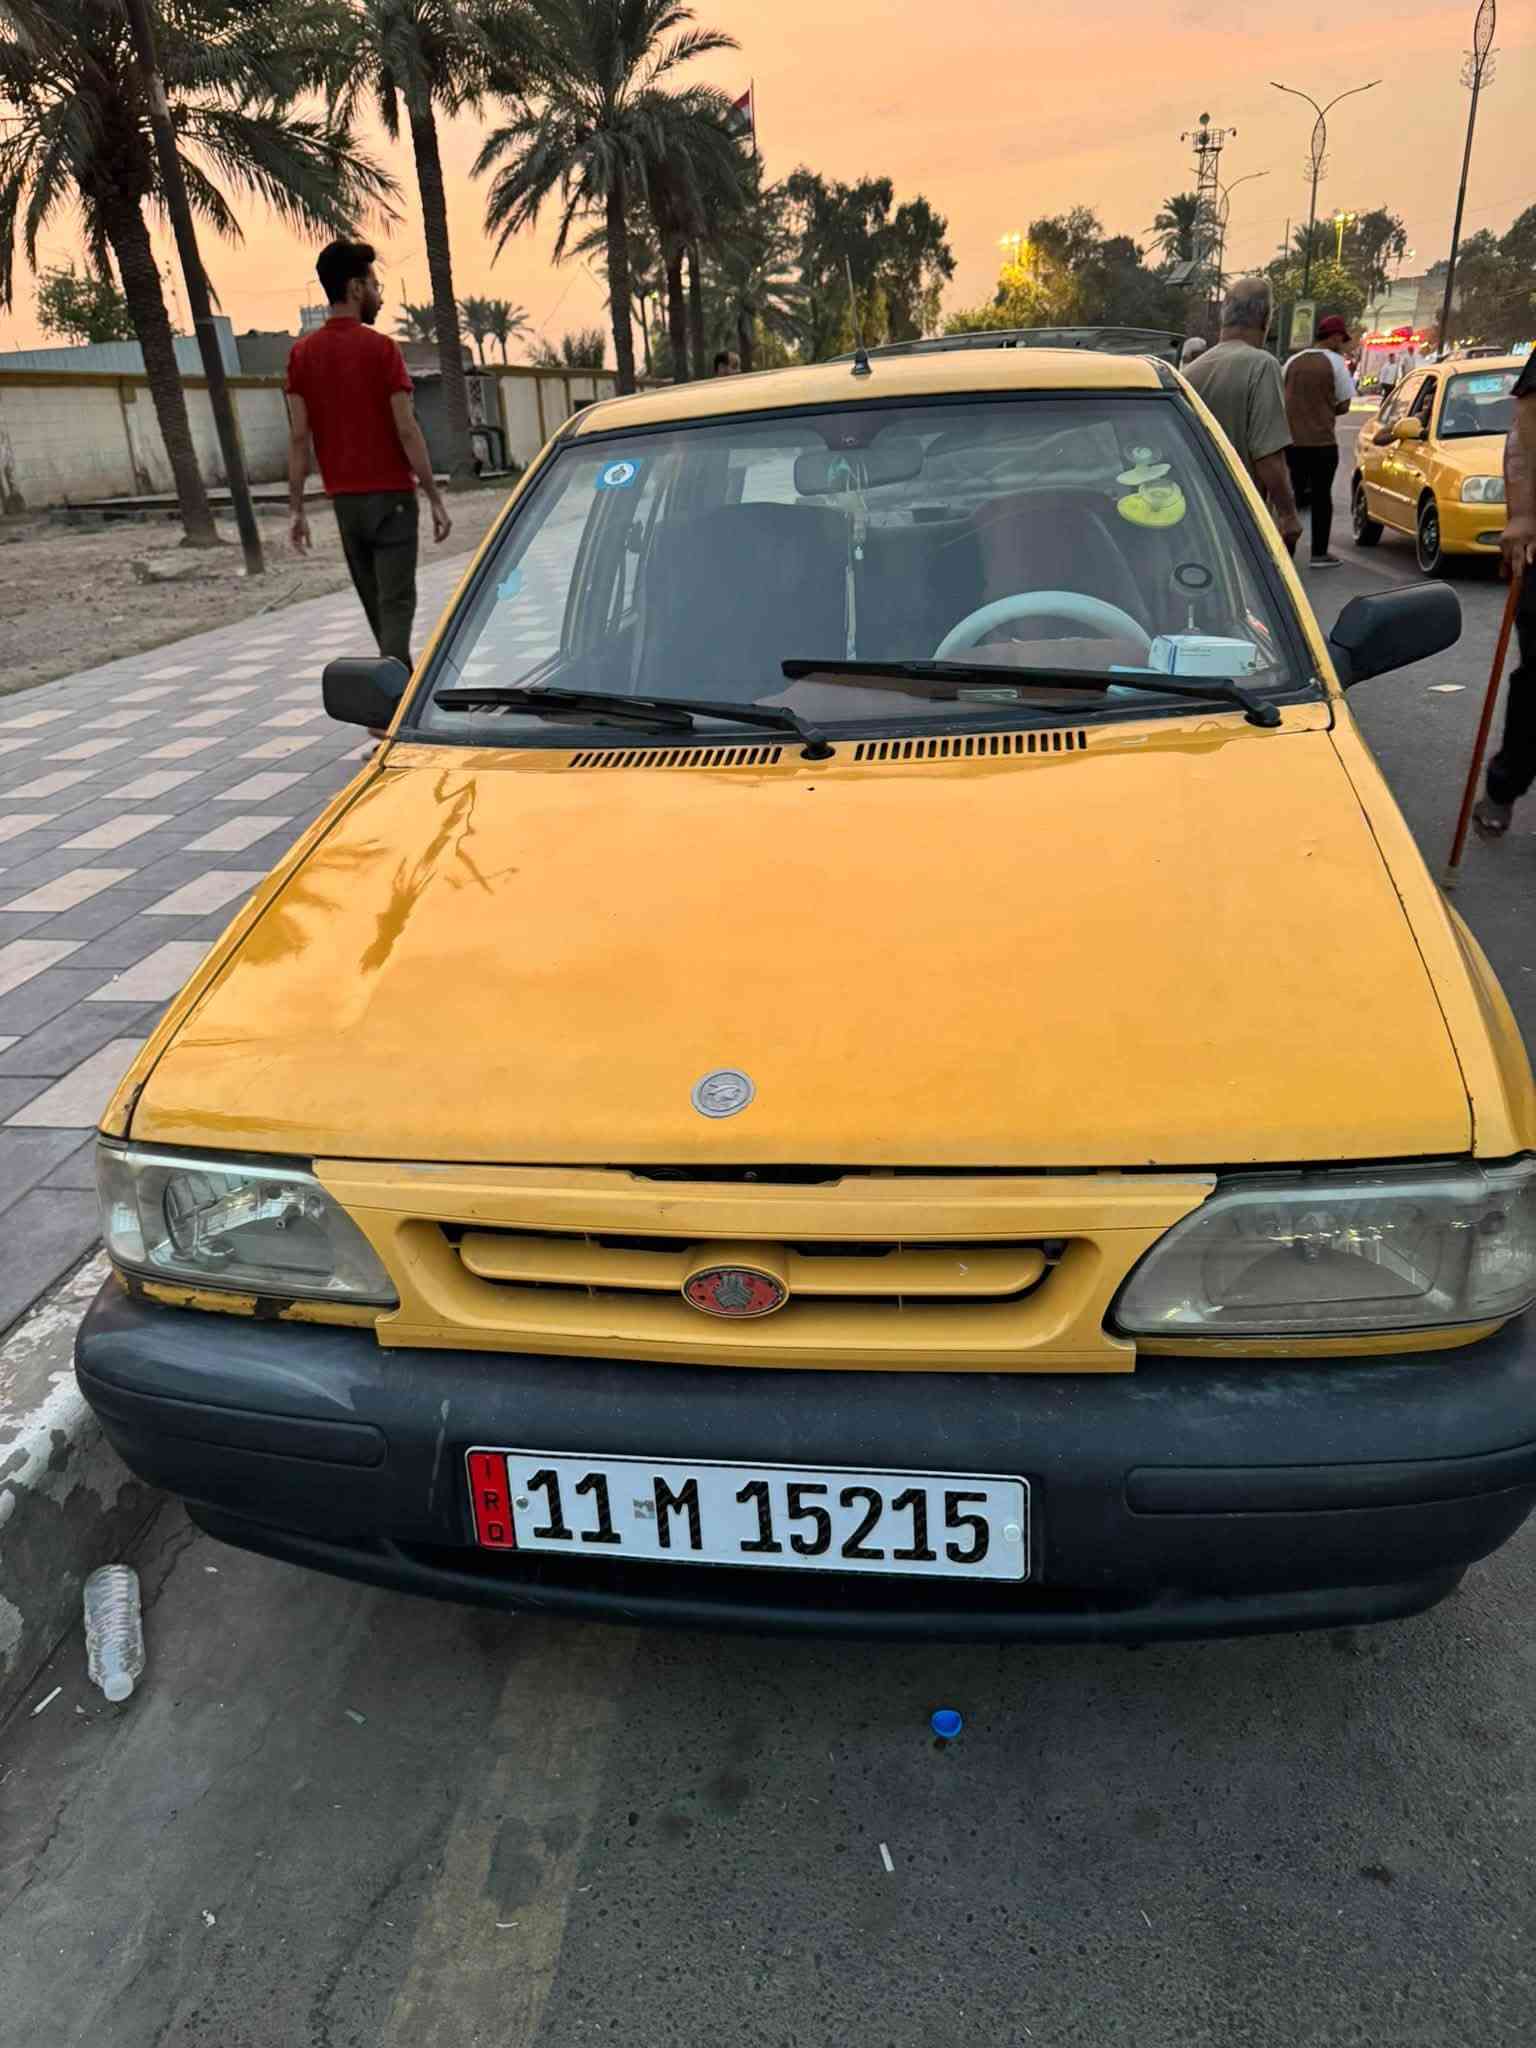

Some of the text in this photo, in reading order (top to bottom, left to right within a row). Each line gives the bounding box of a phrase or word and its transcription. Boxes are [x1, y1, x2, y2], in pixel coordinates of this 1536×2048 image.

[526, 1468, 991, 1563] 11 M 15215
